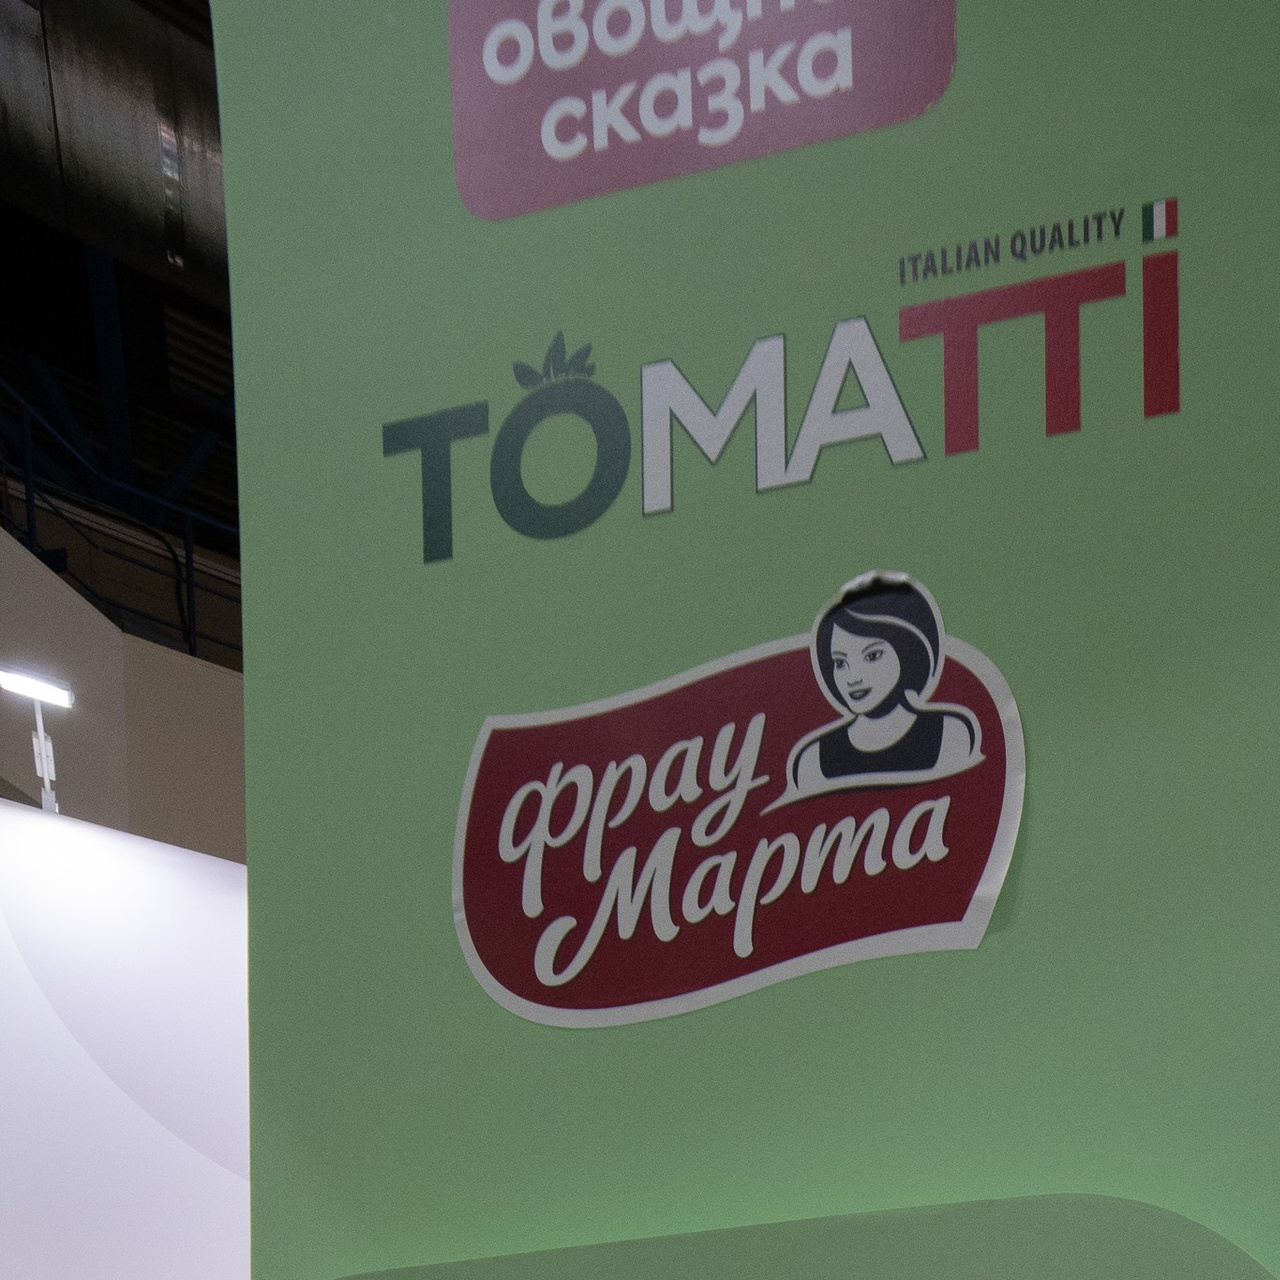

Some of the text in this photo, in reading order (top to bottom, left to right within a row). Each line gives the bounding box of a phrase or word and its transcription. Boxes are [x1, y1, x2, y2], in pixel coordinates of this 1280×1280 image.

[482, 0, 835, 84] овощ
[541, 27, 852, 160] сказка
[898, 207, 1126, 287] ITALIAN QUALITY
[383, 249, 1181, 564] TOMATTI
[499, 713, 769, 919] Фрау
[534, 796, 952, 986] Марта
